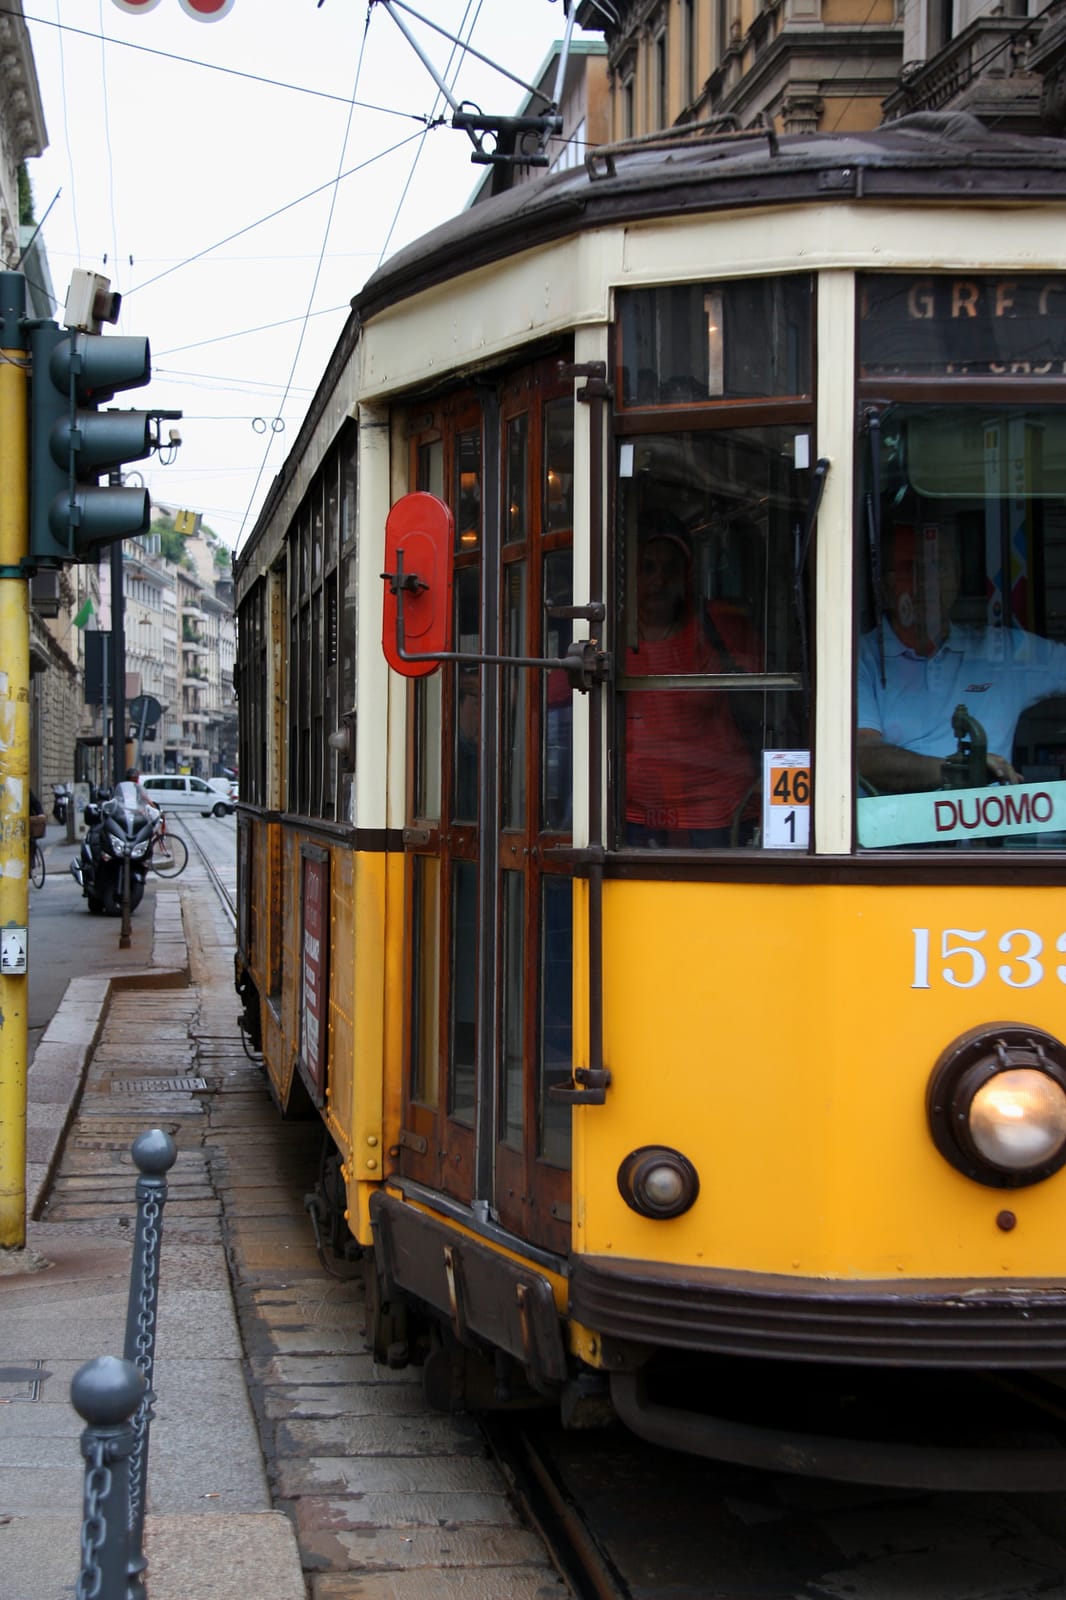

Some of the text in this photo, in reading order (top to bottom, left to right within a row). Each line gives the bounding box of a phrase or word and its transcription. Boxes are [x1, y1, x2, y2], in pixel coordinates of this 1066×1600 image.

[773, 770, 809, 803] 46
[784, 810, 796, 843] 1
[933, 791, 1054, 832] DUOMO
[910, 928, 1066, 989] 153
